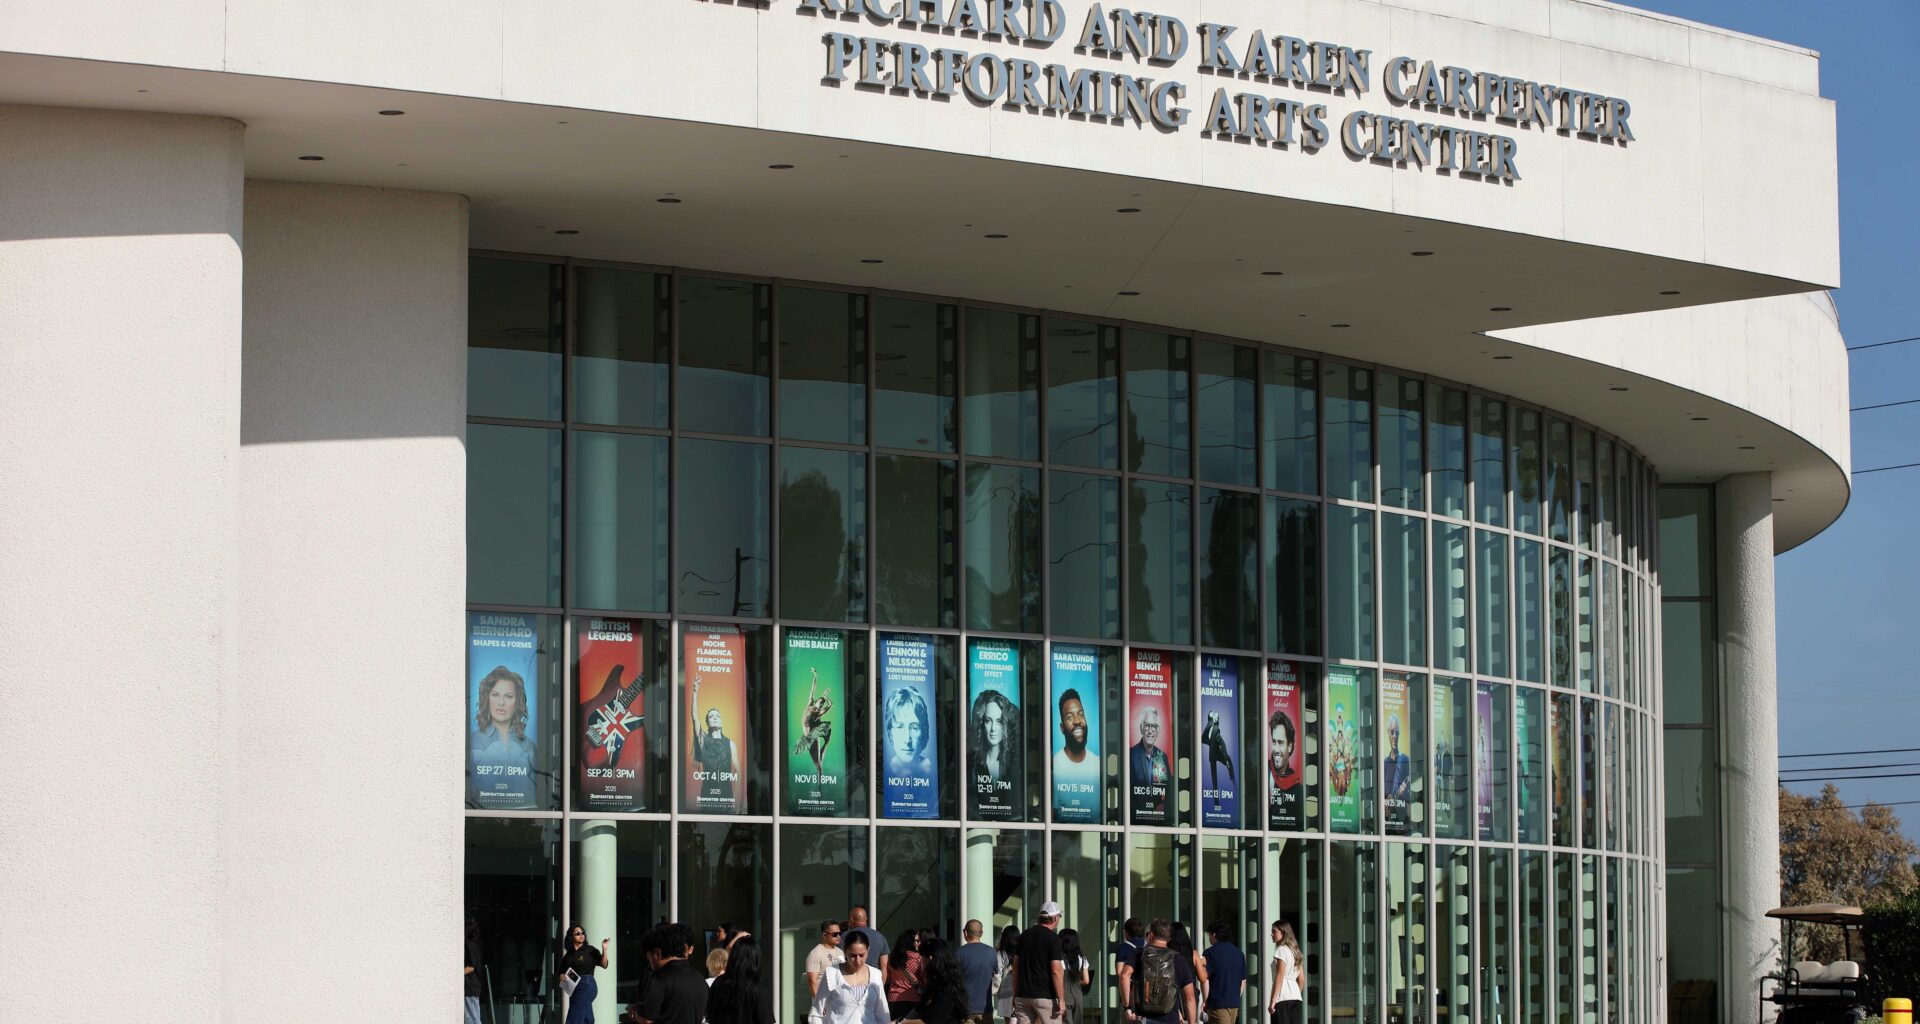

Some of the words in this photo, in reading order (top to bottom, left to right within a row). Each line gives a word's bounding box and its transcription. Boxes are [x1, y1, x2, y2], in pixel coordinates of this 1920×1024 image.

[799, 0, 1066, 43] HARD
[1077, 2, 1189, 61] AND
[1198, 23, 1372, 93] KAREN
[1383, 55, 1636, 144] CARPENTER
[821, 31, 1191, 130] PERFORMING
[1201, 87, 1328, 151] ARTS
[1341, 109, 1521, 182] CENTER
[480, 615, 526, 627] SANDRA
[591, 620, 630, 631] BRITISH
[473, 625, 532, 638] BERNHARD
[588, 631, 633, 642] LEGENDS
[789, 630, 819, 639] ALONZO
[820, 632, 839, 641] KING
[473, 639, 500, 647] SHAPES
[508, 641, 532, 649] FORMS
[703, 640, 726, 648] NOCHE
[789, 639, 810, 649] LINES
[811, 640, 839, 650] BALLET
[976, 641, 1011, 651] MELISSA
[696, 648, 732, 656] FLAMENCA
[886, 646, 920, 658] LENNON
[920, 649, 928, 658] &
[978, 651, 1009, 661] ERRICO
[1137, 651, 1160, 662] DAVID
[696, 657, 733, 665] SEARCHING
[888, 656, 926, 668] NILSSON:
[1053, 653, 1095, 664] BARATUNDE
[1056, 661, 1092, 672] THURSTON
[1136, 661, 1162, 672] BENOIT
[1271, 662, 1291, 673] DAVID
[1212, 669, 1221, 678] BY
[1208, 678, 1225, 688] KYLE
[1135, 688, 1163, 697] CHRISTMAS
[1201, 686, 1233, 698] ABRAHAM
[476, 765, 493, 775] SEP
[493, 765, 505, 775] 27
[507, 766, 527, 776] 8PM
[587, 768, 602, 778] SEP
[602, 768, 613, 778] 28
[616, 768, 635, 779] 3PM
[693, 771, 710, 781] OCT
[711, 771, 717, 781] 4
[720, 772, 738, 782] 8PM
[794, 774, 811, 784] NOV
[812, 774, 818, 784] 8
[820, 775, 837, 785] 8PM
[888, 777, 904, 786] NOV
[905, 777, 911, 787] 9
[913, 777, 930, 787] 3PM
[977, 774, 993, 784] NOV
[977, 784, 993, 793] 12-13
[996, 780, 1012, 790] 7PM
[1057, 783, 1071, 793] NOV
[1071, 783, 1078, 793] 15
[1080, 784, 1094, 793] 8PM
[1133, 786, 1146, 795] DEC
[1146, 786, 1151, 795] 6
[1152, 786, 1166, 796] 8PM
[1203, 789, 1213, 798] DEC
